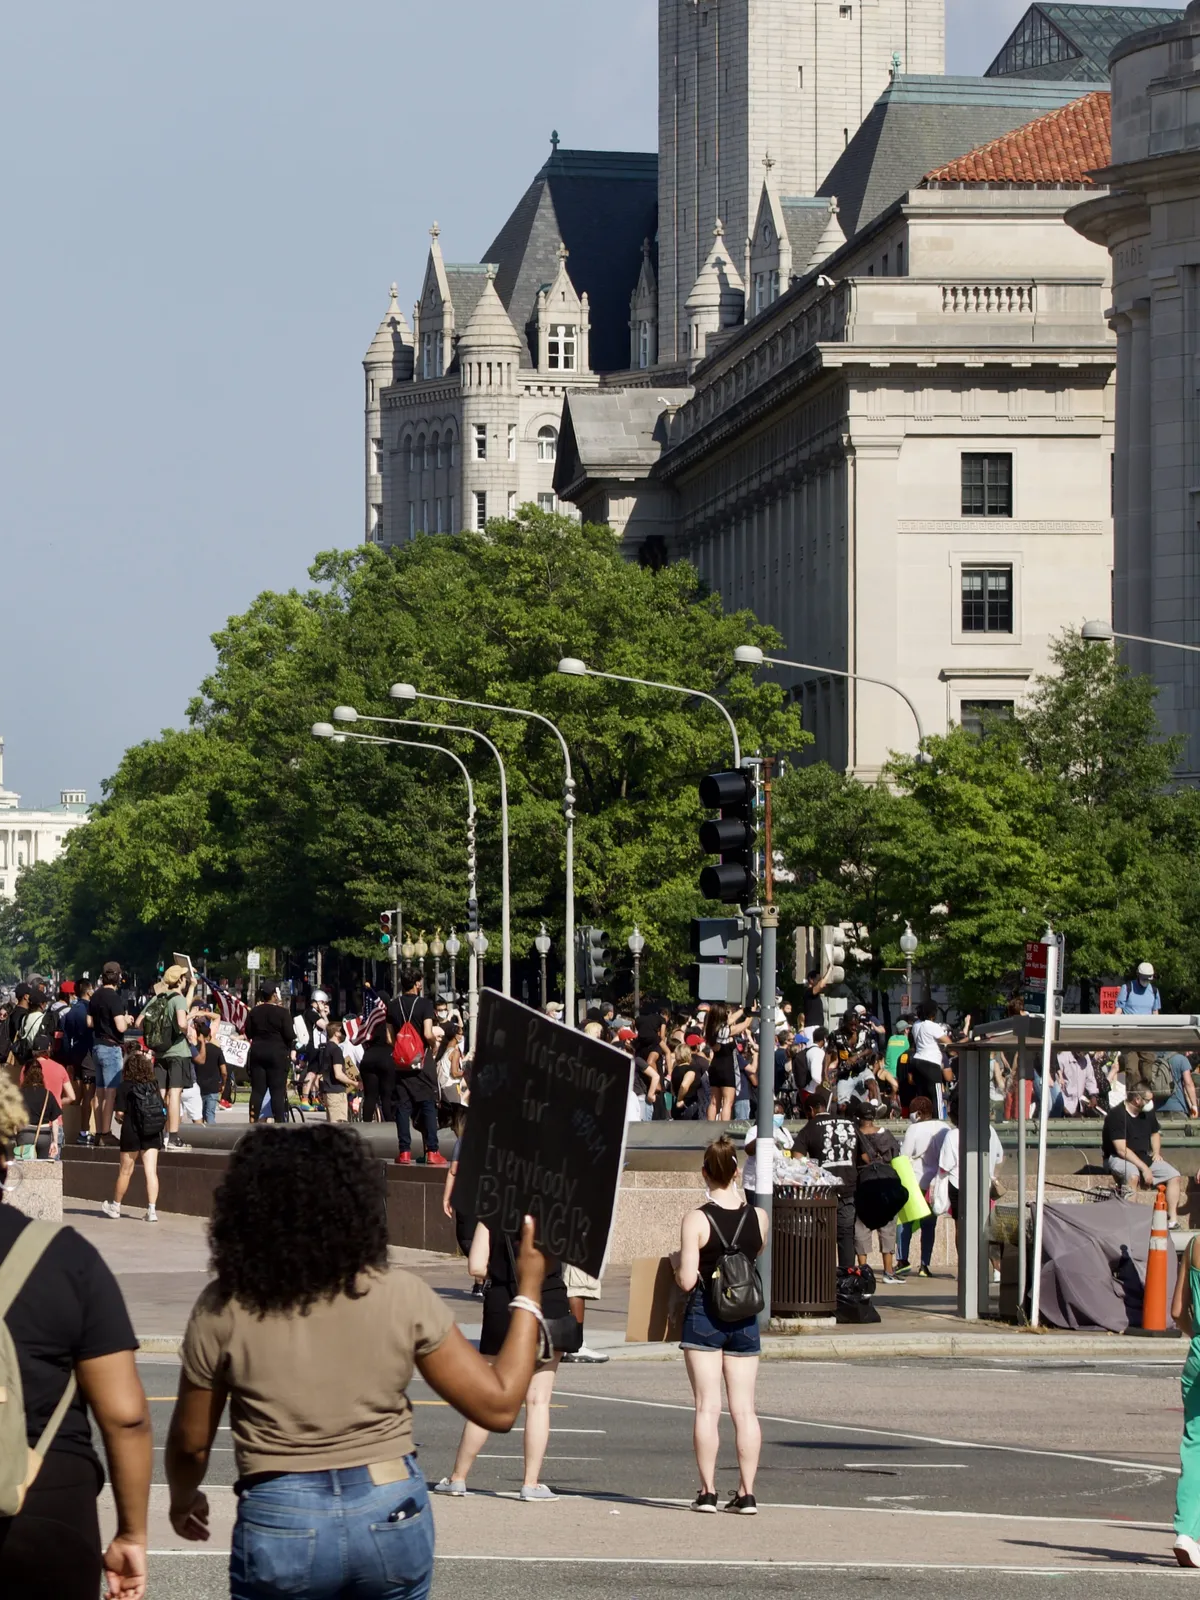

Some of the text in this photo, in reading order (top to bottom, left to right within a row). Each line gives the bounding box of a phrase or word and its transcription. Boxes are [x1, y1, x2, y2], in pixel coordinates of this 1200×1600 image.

[522, 1078, 550, 1123] for
[525, 1017, 618, 1116] Protesting
[484, 1121, 579, 1214] Everybody
[475, 1174, 591, 1264] BLACK
